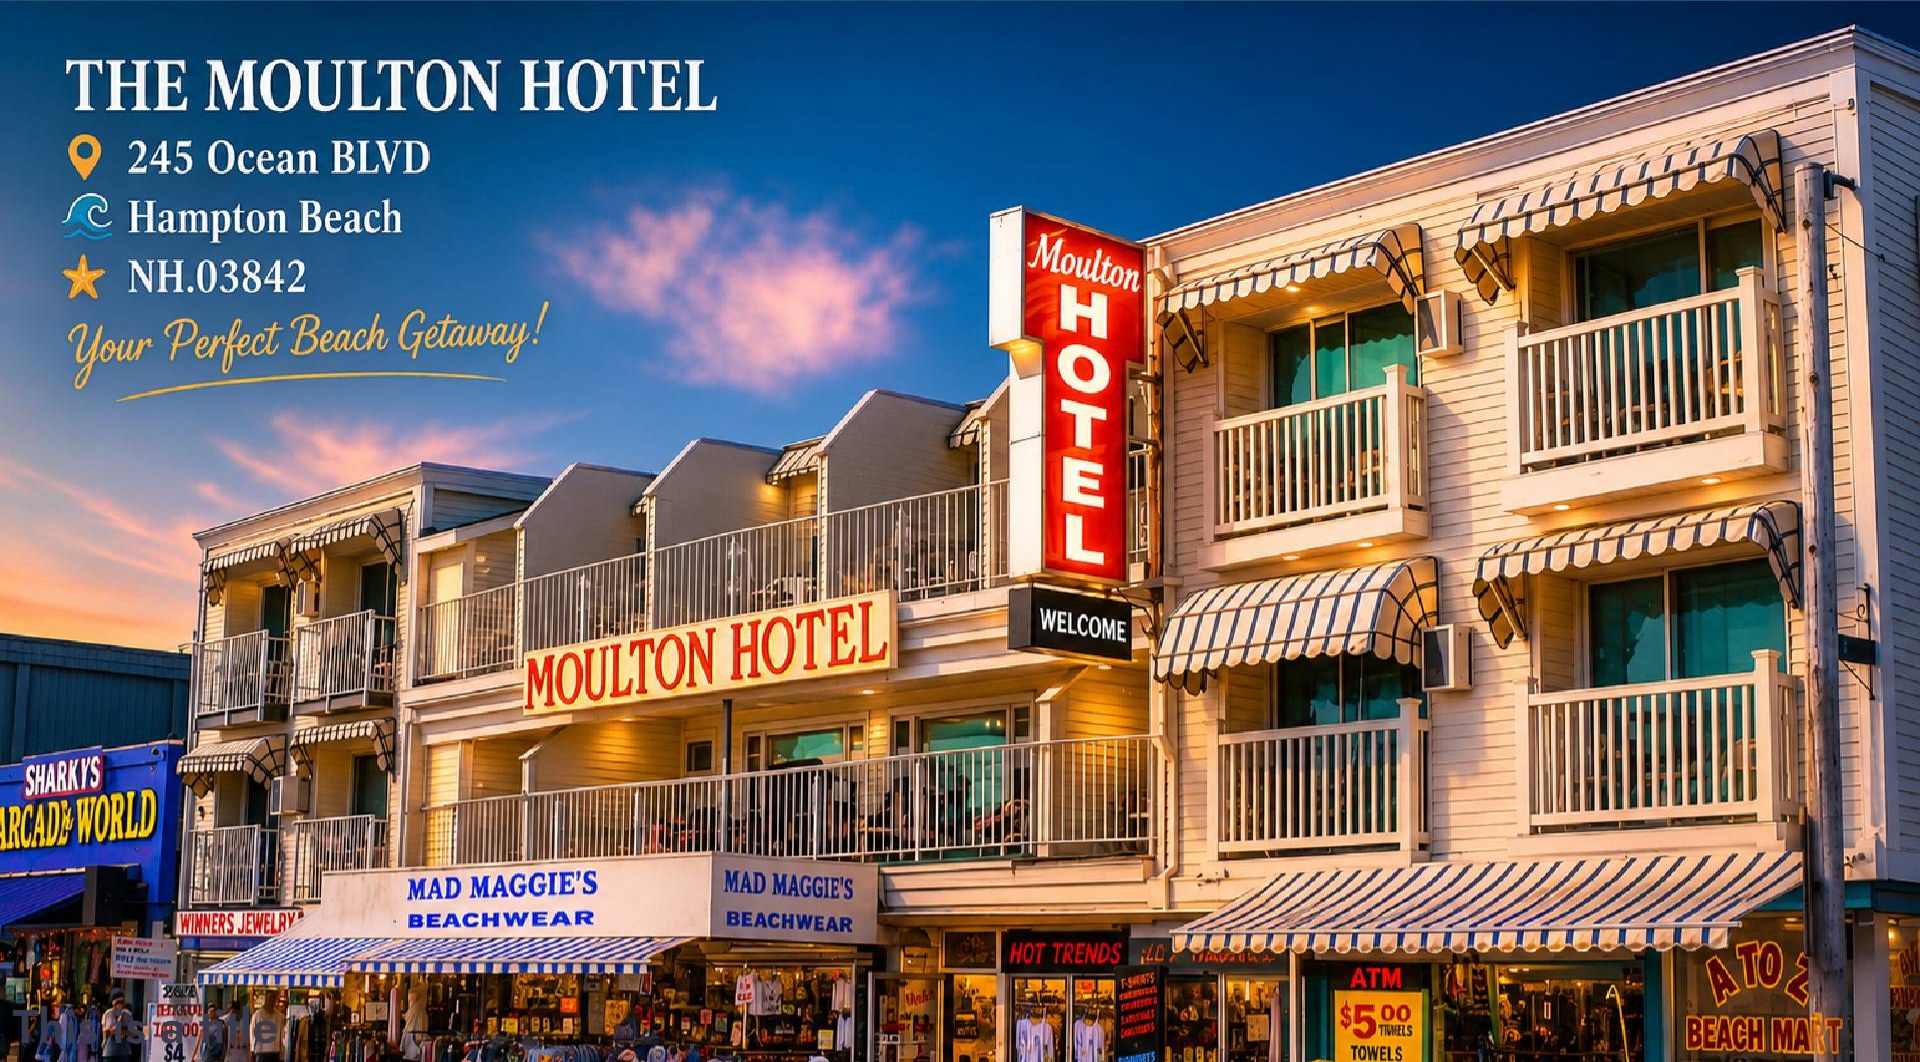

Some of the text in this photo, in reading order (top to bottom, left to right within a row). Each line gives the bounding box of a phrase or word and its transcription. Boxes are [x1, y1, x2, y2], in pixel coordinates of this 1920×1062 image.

[1027, 232, 1141, 293] Moulton
[1057, 283, 1112, 566] HOTEL
[1038, 607, 1128, 644] WELCOME
[524, 600, 888, 710] MOULTON HOTEL
[76, 789, 157, 844] WORLD
[407, 869, 599, 902] MAD MAGGIE'S
[724, 869, 854, 900] MAD MAGGIE'S
[180, 912, 235, 934] WINNERS
[407, 910, 595, 929] BEACHWEAR
[725, 910, 854, 933] BEACHWEAR
[1009, 942, 1043, 965] HOT
[1051, 941, 1123, 965] TRENDS
[1349, 967, 1403, 989] ATM
[1705, 955, 1741, 1008] A
[1735, 940, 1784, 989] TO
[1686, 1012, 1844, 1055] BEACH MART
[1350, 1045, 1403, 1062] TOWELS
